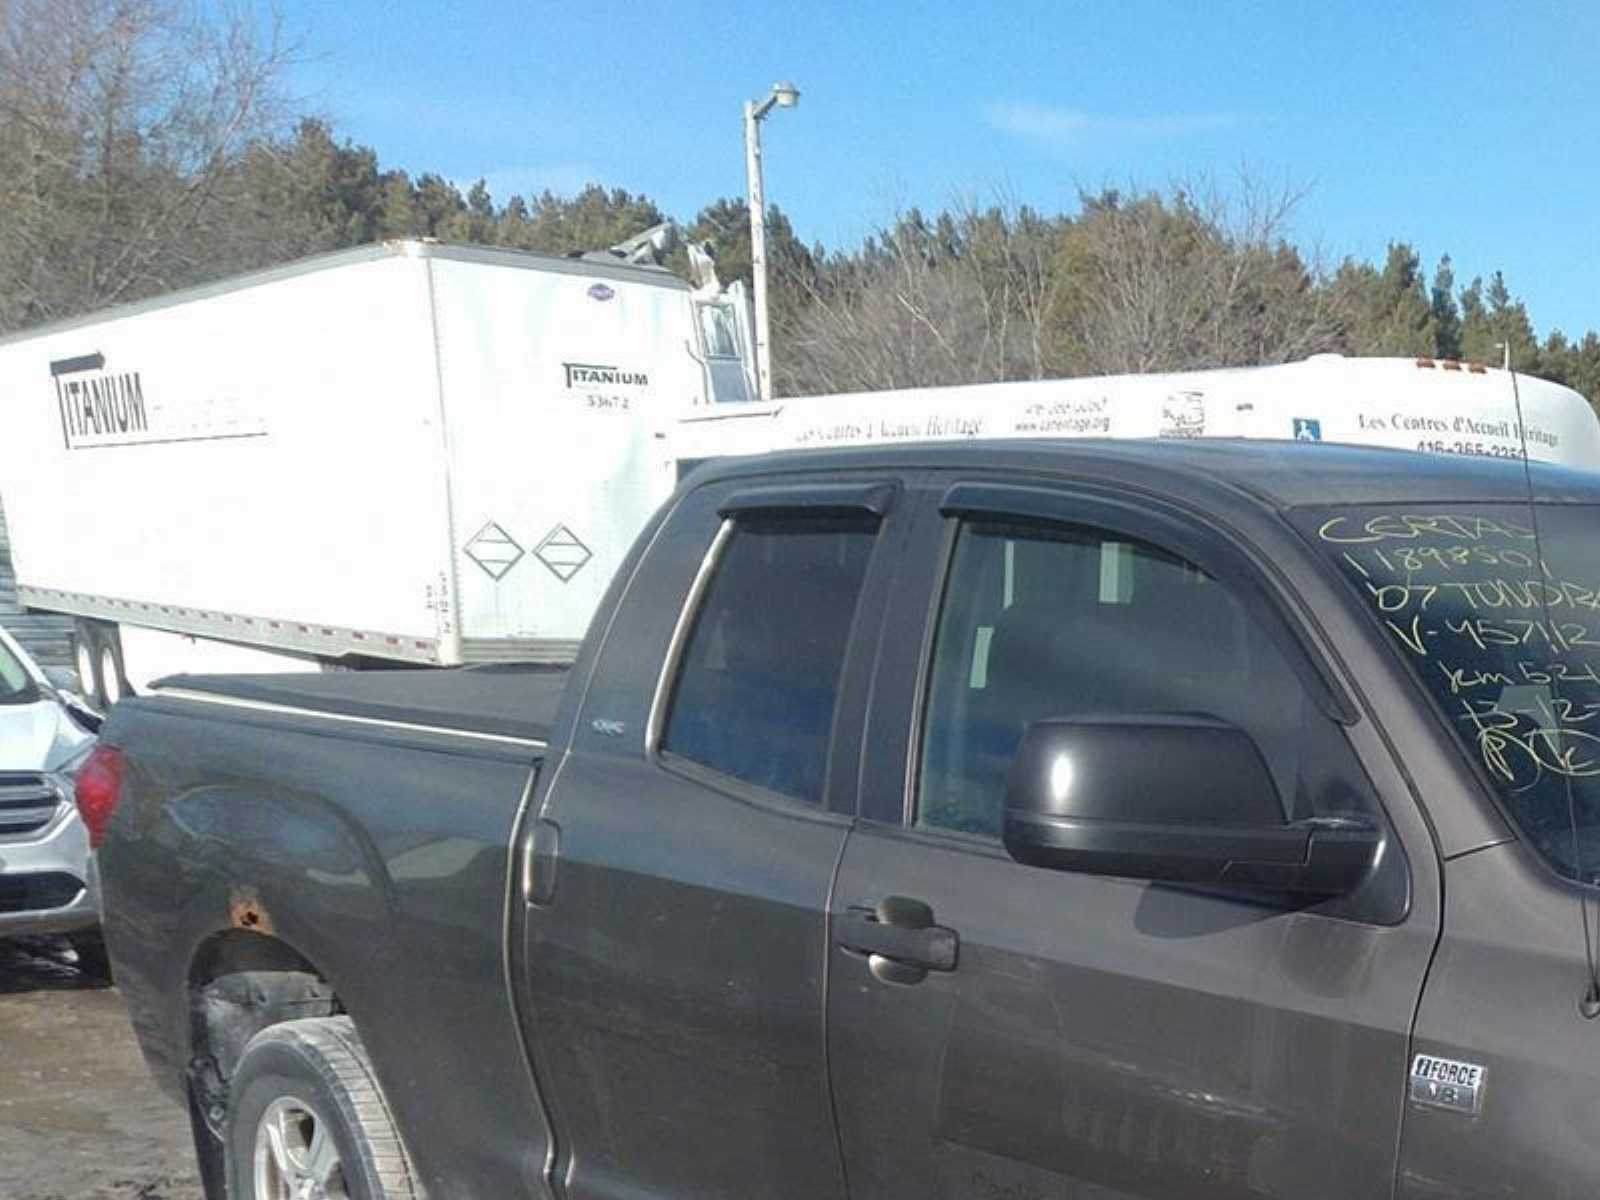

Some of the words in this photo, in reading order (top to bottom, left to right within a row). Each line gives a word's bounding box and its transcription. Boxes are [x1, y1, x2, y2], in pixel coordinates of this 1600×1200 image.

[561, 362, 649, 388] TITANIUM
[50, 351, 148, 450] TITANIUM
[1357, 412, 1386, 430] Les
[1390, 412, 1449, 432] Centres
